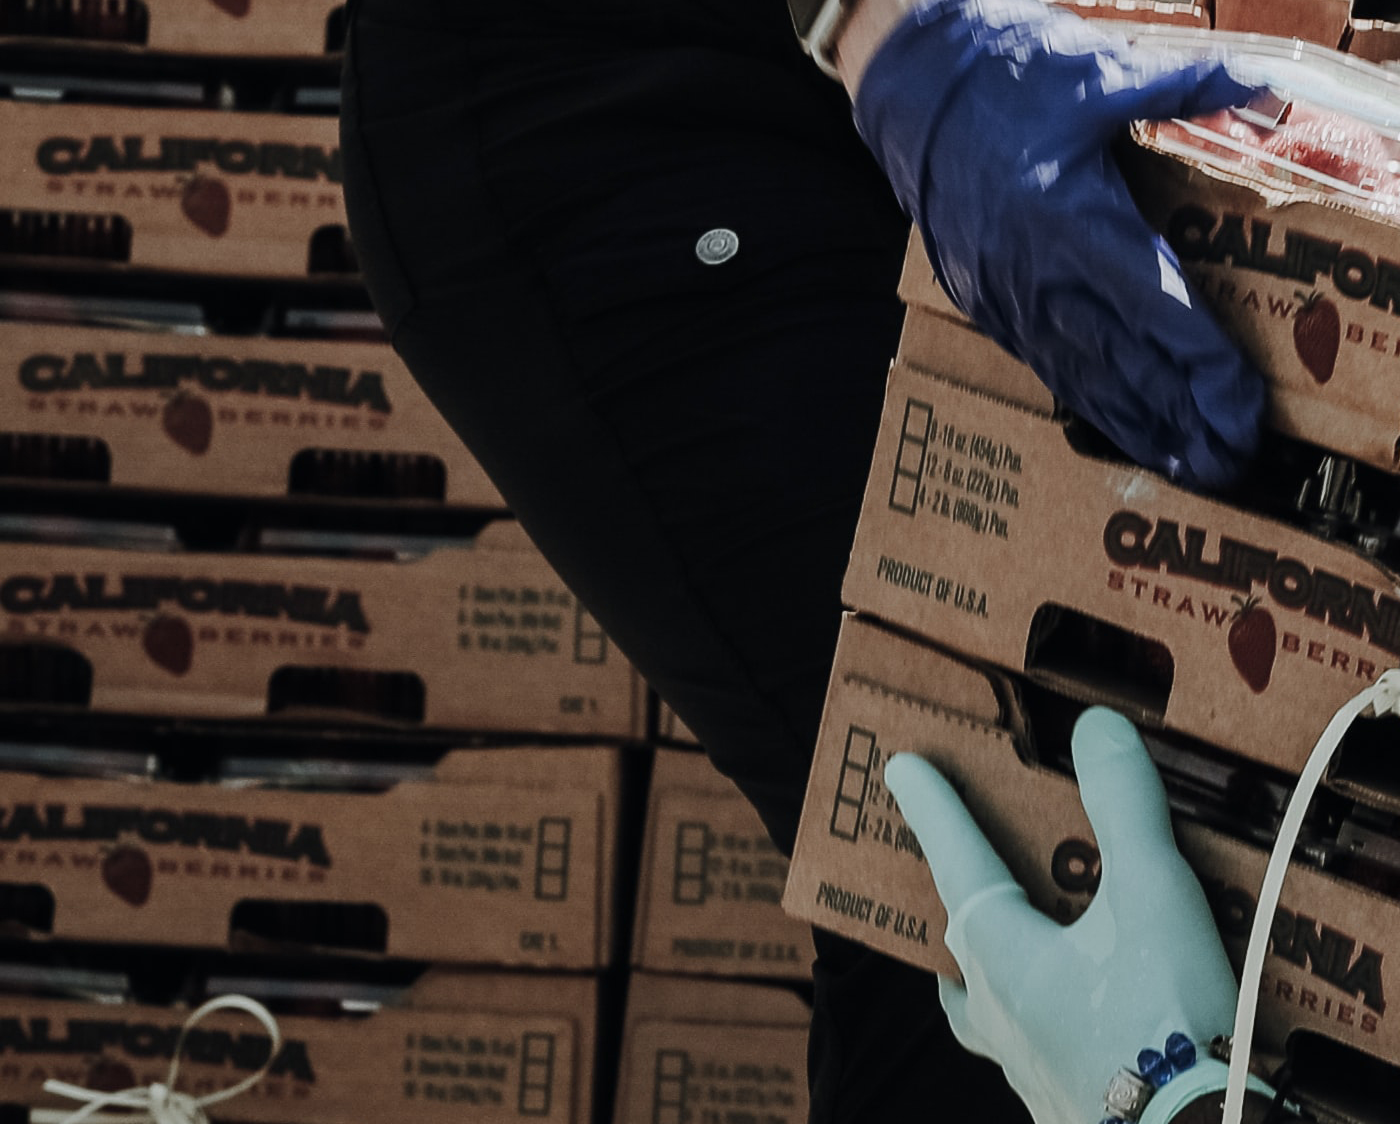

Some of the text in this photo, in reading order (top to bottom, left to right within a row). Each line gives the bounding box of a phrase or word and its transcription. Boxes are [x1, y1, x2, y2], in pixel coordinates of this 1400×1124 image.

[18, 352, 392, 415] CALIFORNIA
[0, 572, 371, 635] CALIFORNIA
[876, 554, 989, 619] PRODUCT OF U.S.A.
[1107, 569, 1229, 628] STRAW
[0, 804, 332, 869] ALIFORNIA
[815, 880, 929, 947] PRODUCT OF U.S.A.
[1264, 978, 1378, 1035] RRIES
[0, 1018, 316, 1084] ALIFORNIA
